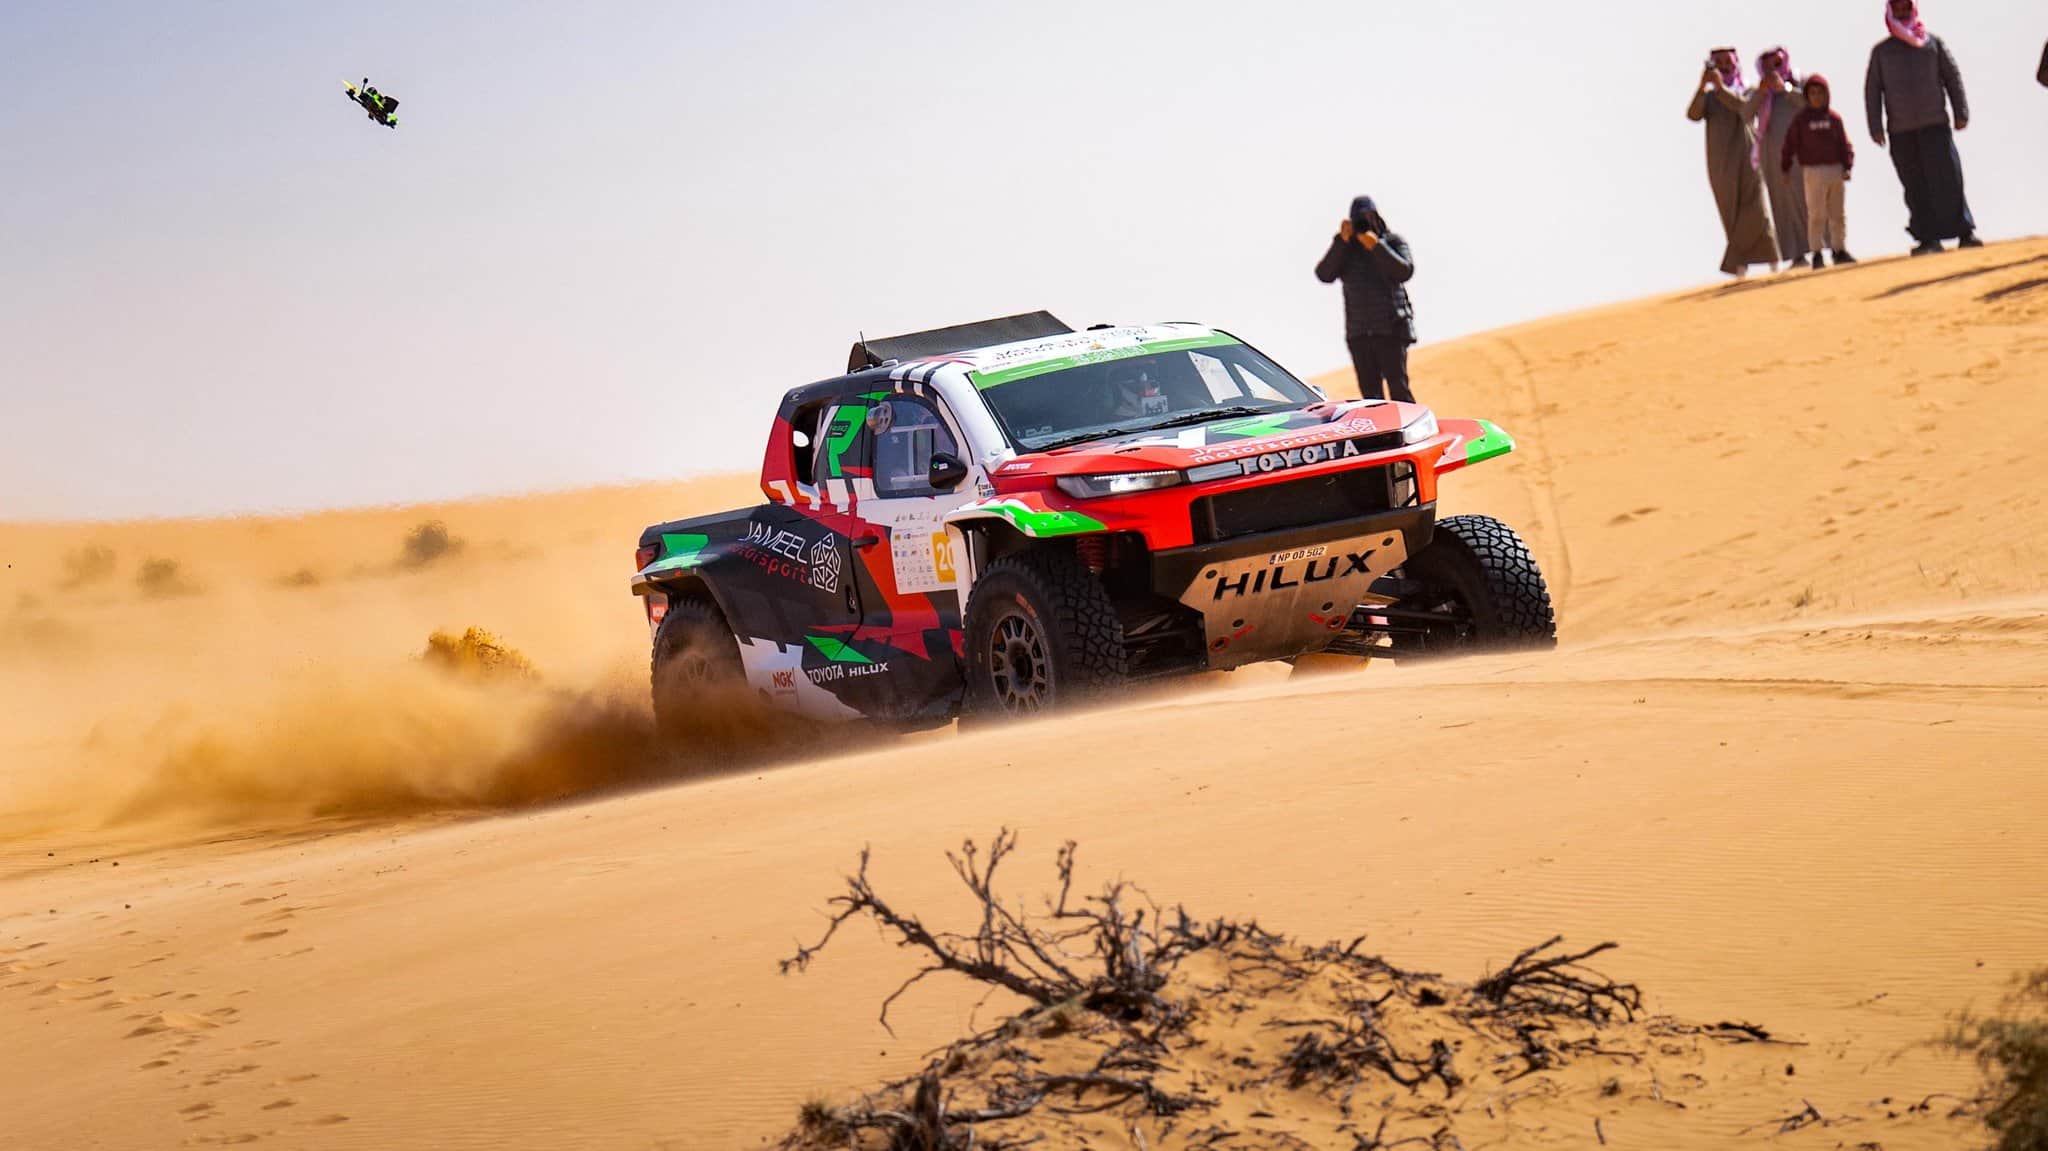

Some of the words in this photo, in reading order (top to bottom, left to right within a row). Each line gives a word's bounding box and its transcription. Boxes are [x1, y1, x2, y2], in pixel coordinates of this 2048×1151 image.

[1238, 439, 1360, 476] TOYOTA
[737, 521, 808, 565] JAMEEL
[1213, 549, 1377, 601] HILUX
[772, 671, 794, 689] NGK
[808, 664, 845, 684] TOYOTA
[849, 662, 889, 678] HILUX
